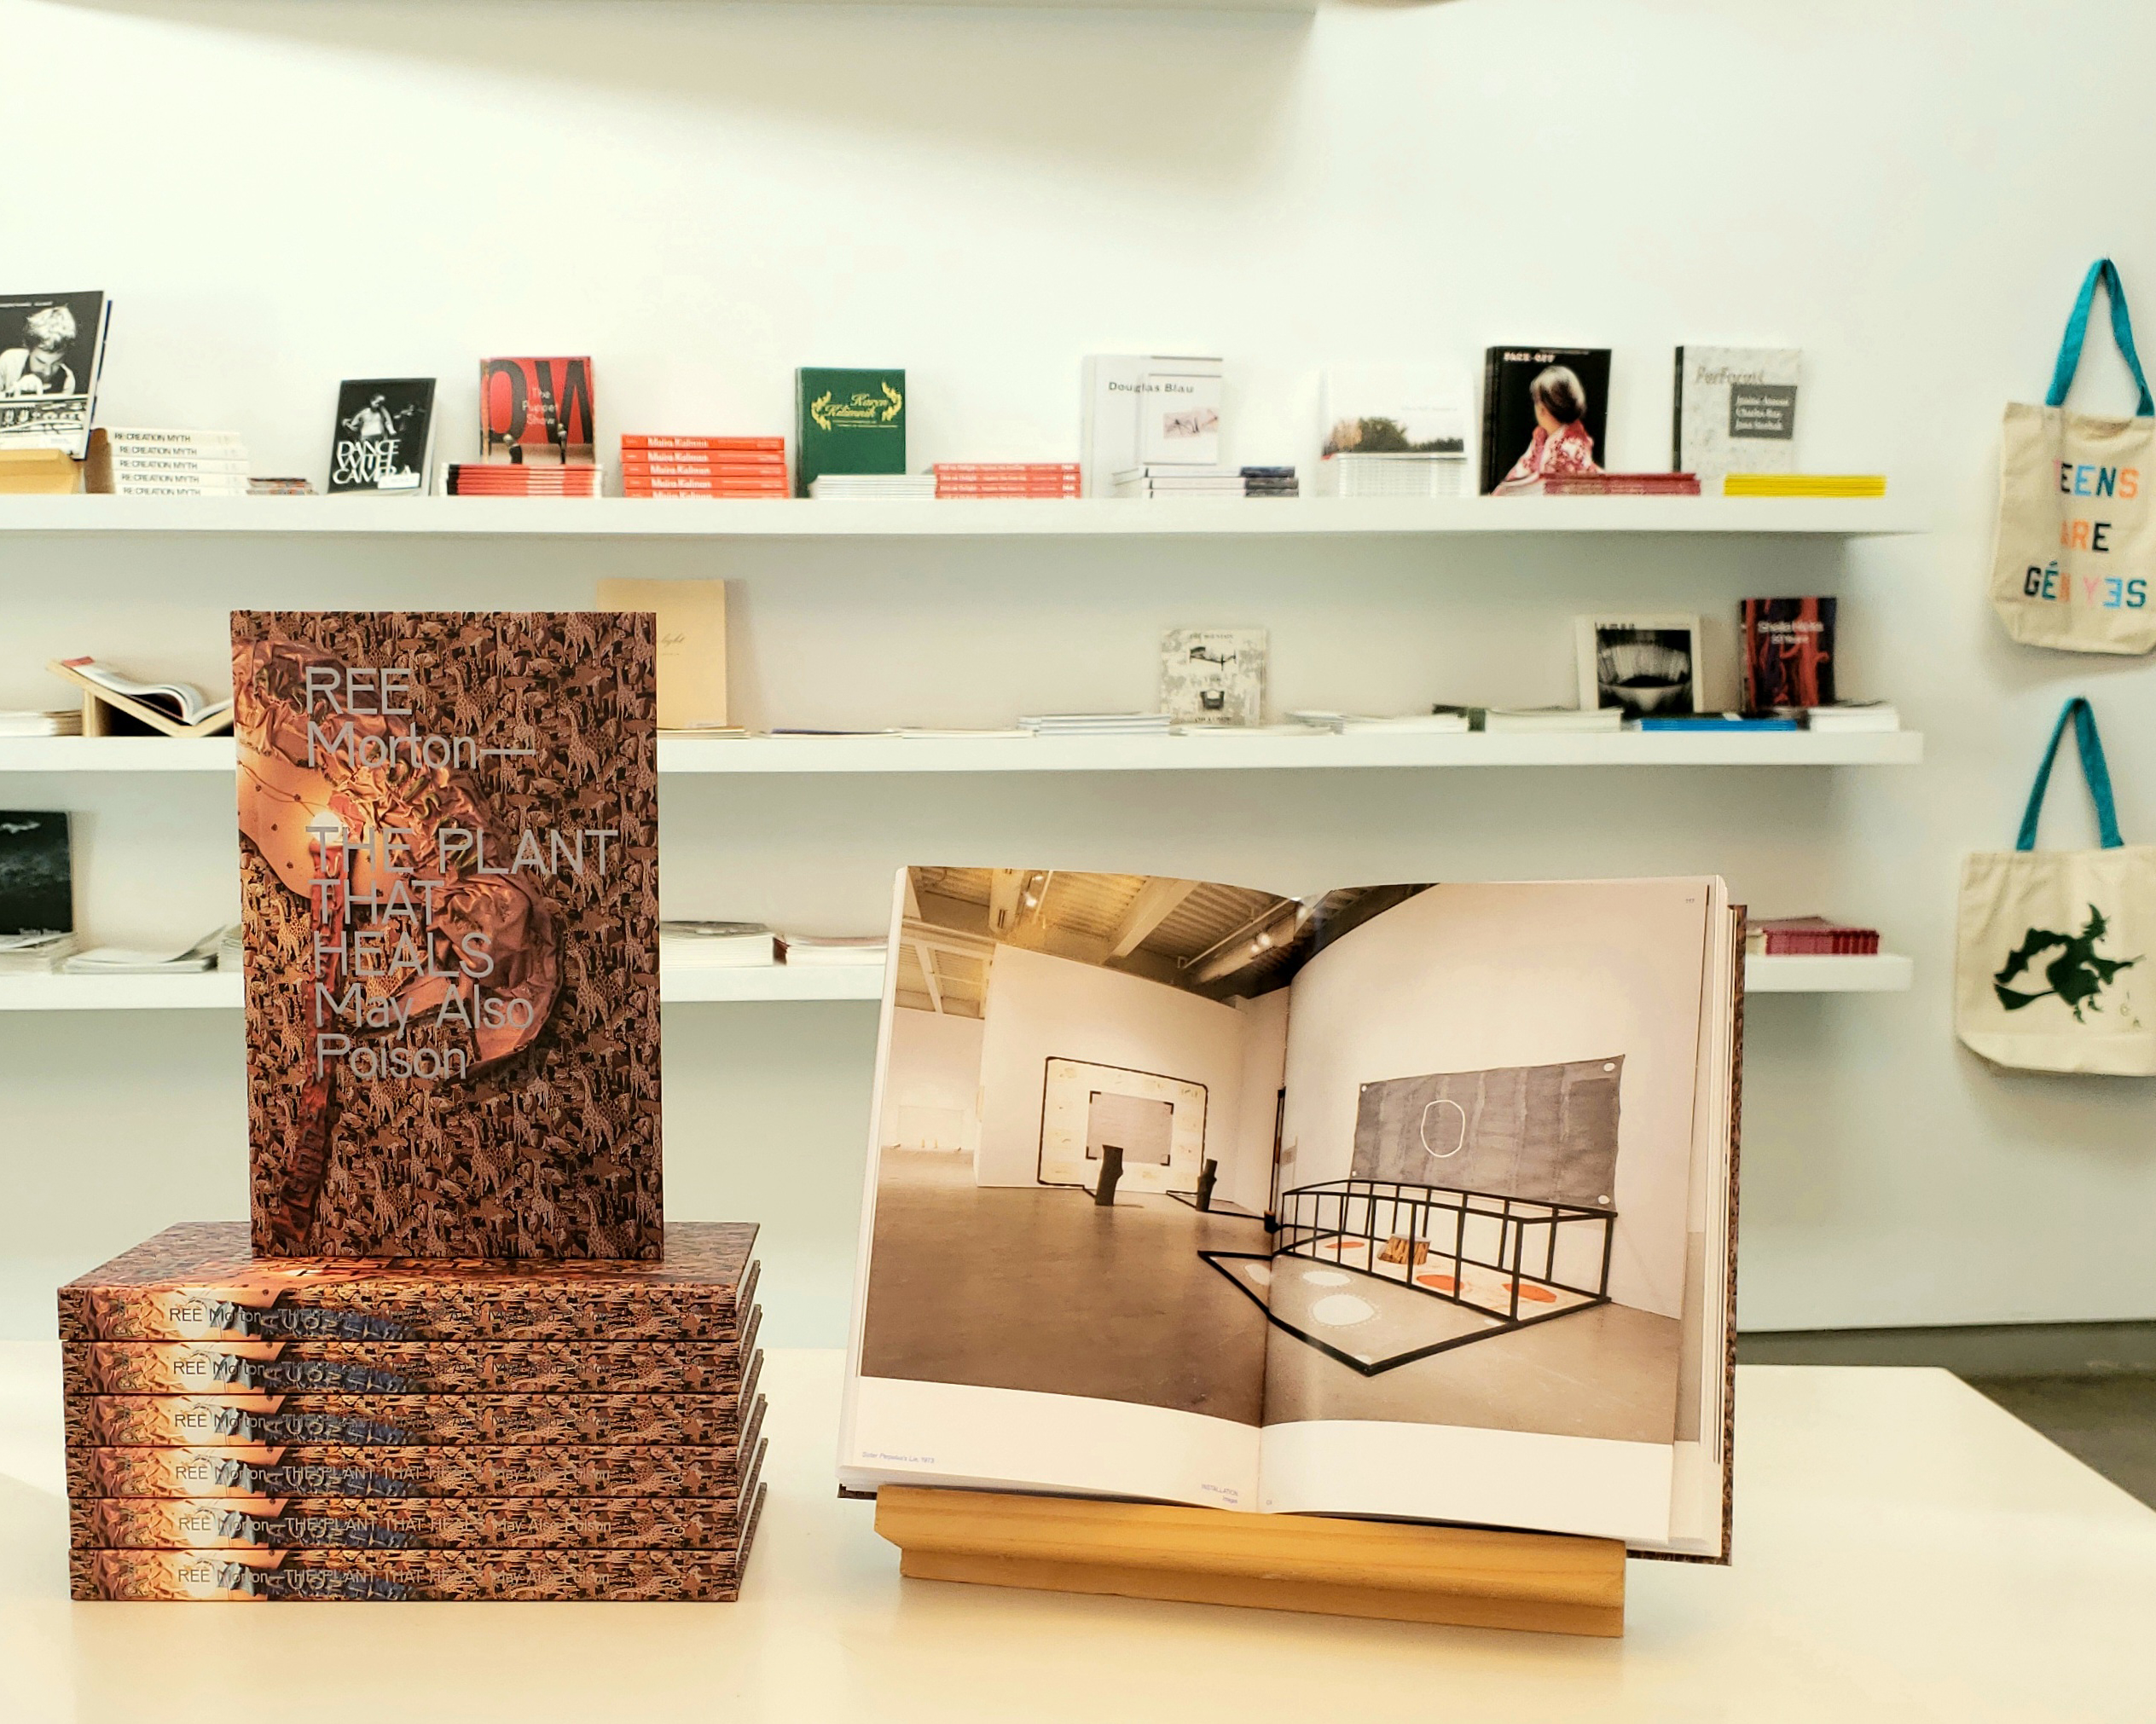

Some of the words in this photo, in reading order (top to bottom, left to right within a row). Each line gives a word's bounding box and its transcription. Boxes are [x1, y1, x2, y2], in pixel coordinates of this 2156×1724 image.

[531, 387, 551, 399] The
[1109, 381, 1159, 393] Douglas
[1164, 383, 1194, 393] Blau
[522, 400, 559, 413] Puppet
[526, 414, 555, 425] Show
[167, 434, 191, 443] MYTH
[337, 439, 401, 456] DANCE
[647, 451, 674, 461] Maira
[675, 452, 709, 462] Kalman
[173, 461, 198, 470] MYTH
[650, 465, 675, 475] Maira
[676, 465, 711, 475] Kalman
[305, 667, 413, 715] REE
[305, 826, 414, 874] THE
[438, 827, 619, 876] PLANT
[308, 879, 444, 925] THAT
[313, 930, 495, 979] HEALS
[315, 982, 413, 1042] May
[435, 983, 535, 1030] Also
[315, 1033, 467, 1080] Poison
[169, 1308, 203, 1322] REE
[173, 1361, 206, 1375] REE
[175, 1414, 208, 1427] REE
[176, 1466, 208, 1480] REE
[382, 1466, 422, 1480] THAT
[179, 1518, 211, 1532] REE
[385, 1518, 423, 1532] THAT
[178, 1570, 210, 1583] REE
[384, 1570, 423, 1583] THAT
